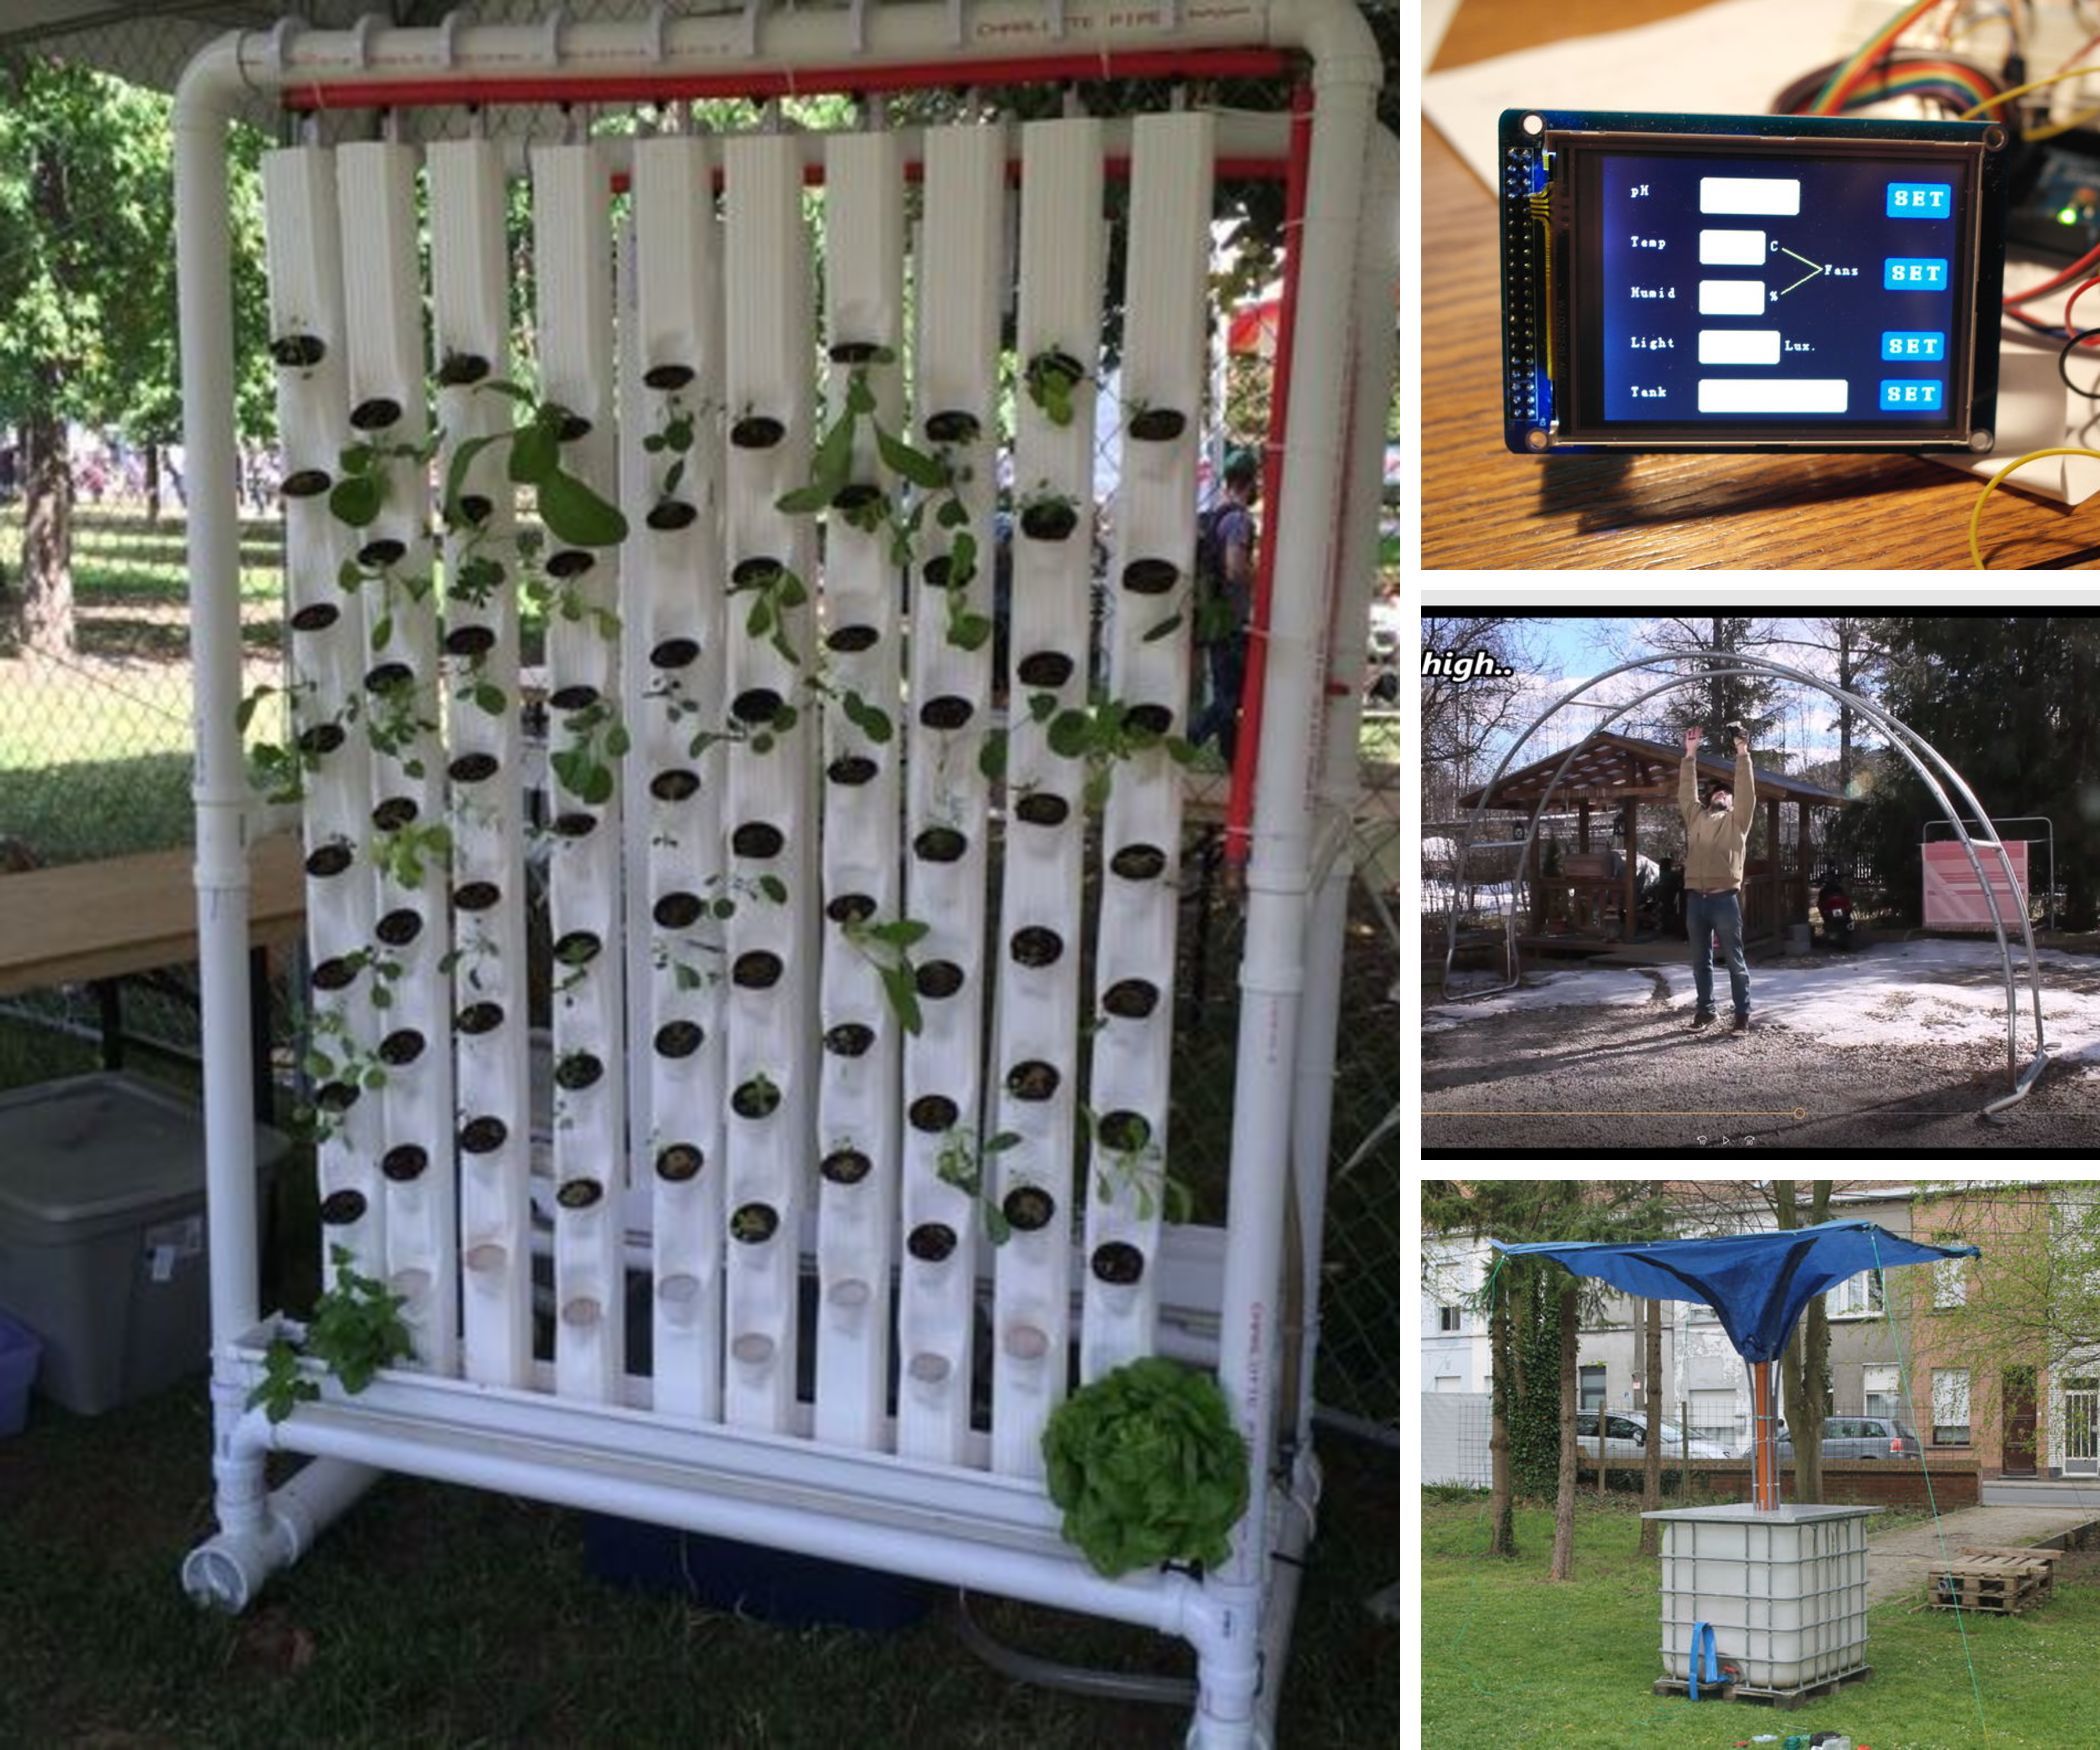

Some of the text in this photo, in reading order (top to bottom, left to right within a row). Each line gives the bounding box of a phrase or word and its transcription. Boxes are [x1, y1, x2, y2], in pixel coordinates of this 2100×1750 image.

[1630, 184, 1650, 198] pH
[1893, 189, 1944, 207] SET
[1630, 235, 1666, 250] Temp
[1769, 240, 1779, 252] C
[1824, 264, 1859, 276] Fans
[1891, 264, 1941, 282] SET
[1630, 286, 1676, 299] Humid
[1630, 336, 1675, 351] Light
[1784, 340, 1816, 352] Lux.
[1888, 338, 1938, 354] SET
[1630, 386, 1667, 398] Tank
[1887, 386, 1937, 402] SET
